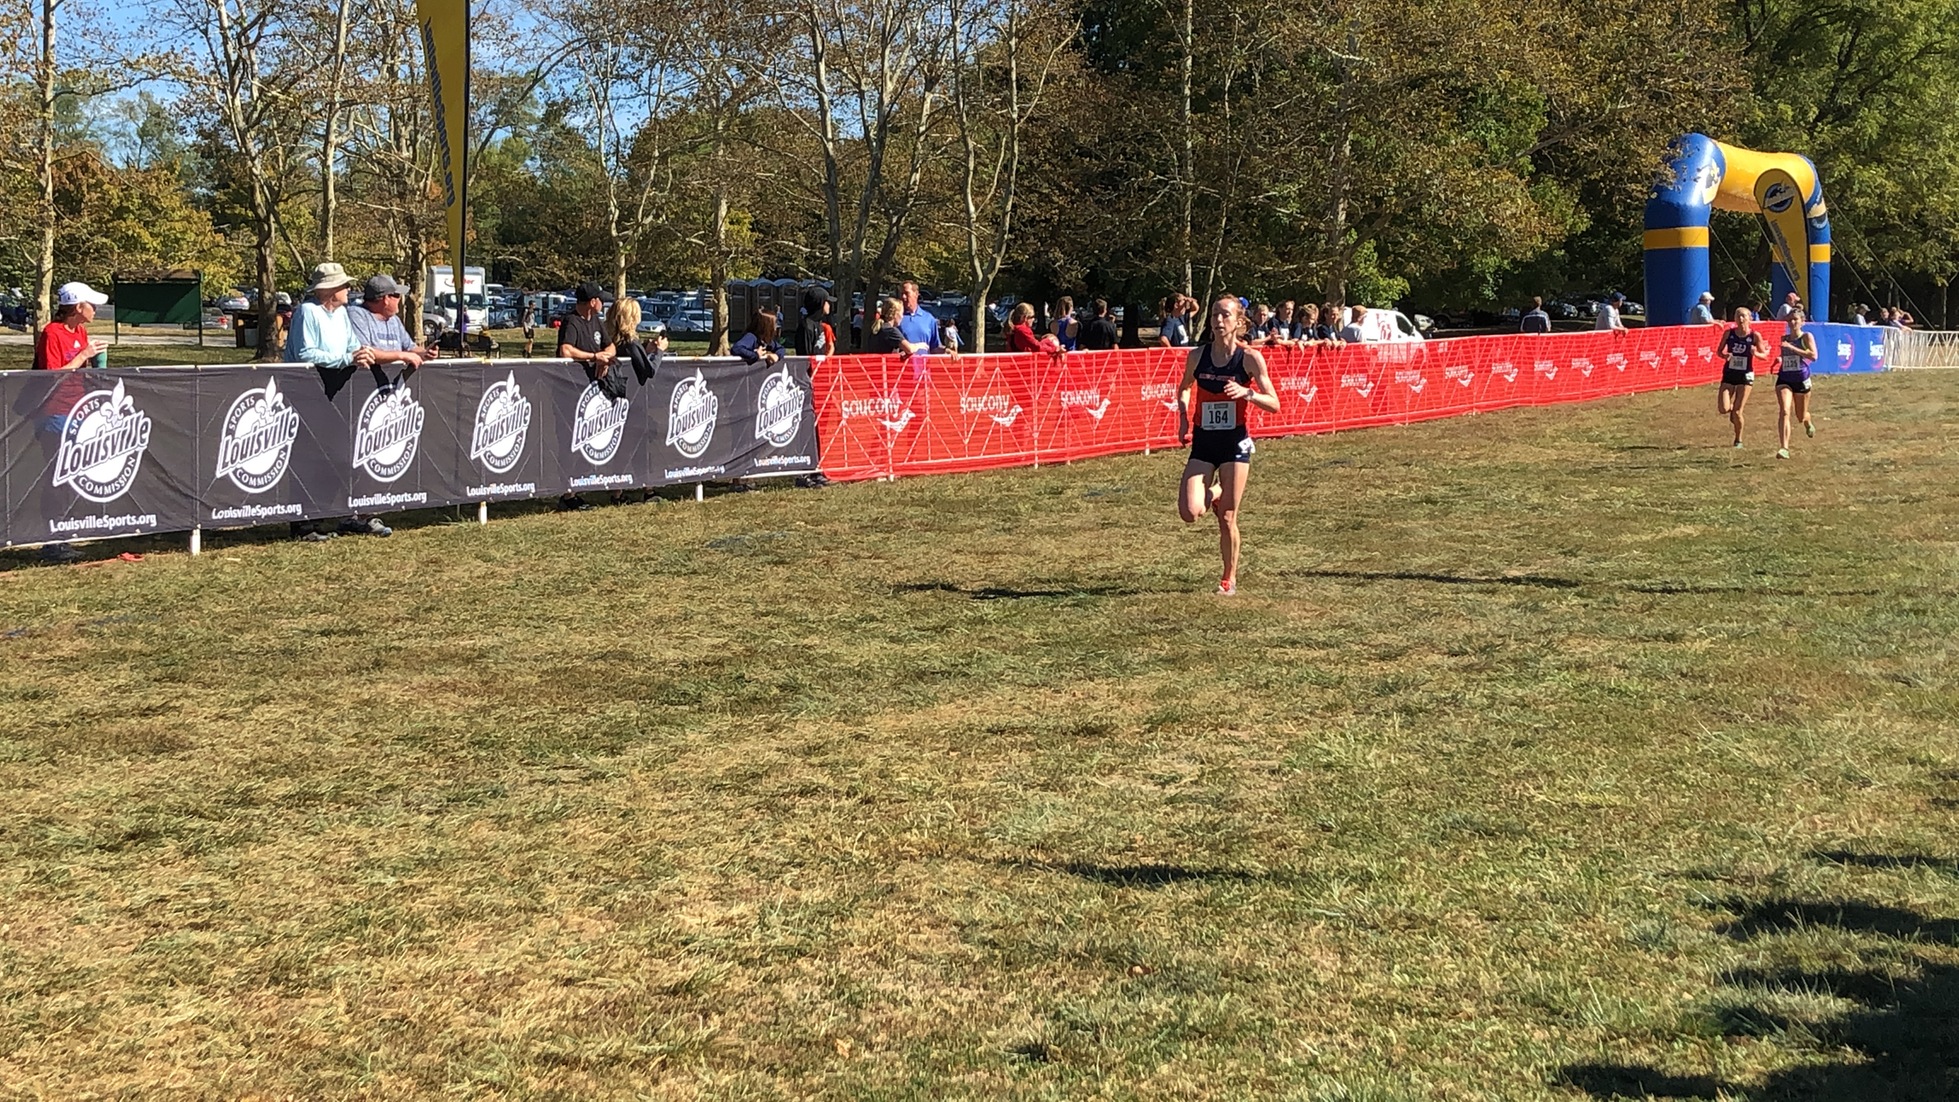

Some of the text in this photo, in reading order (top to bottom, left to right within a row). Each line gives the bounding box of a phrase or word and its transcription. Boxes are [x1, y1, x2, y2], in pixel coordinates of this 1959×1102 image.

[481, 388, 500, 419] SPORTS
[580, 385, 600, 414] SPORTS
[673, 383, 689, 410] SPORTS
[69, 398, 100, 436] SPORTS
[229, 396, 256, 431] SPORTS
[472, 397, 532, 456] Louisville
[667, 390, 719, 443] Louisville
[1208, 410, 1229, 424] 164
[56, 411, 151, 480] Louisville
[218, 407, 299, 475] Louisville
[356, 401, 425, 465] Louisville
[585, 430, 620, 459] COMMISSION
[370, 441, 414, 476] COMMISSION
[486, 435, 522, 467] COMMISSION
[78, 456, 136, 495] COMMISSION
[236, 450, 287, 486] COMMISSION
[570, 474, 633, 488] LouisvilleSports.org
[348, 492, 427, 507] LouisvilleSports.org
[466, 482, 536, 497] LouisvilleSports.org
[50, 514, 157, 532] LouisvilleSports.org
[212, 504, 302, 520] LouisvilleSports.org
